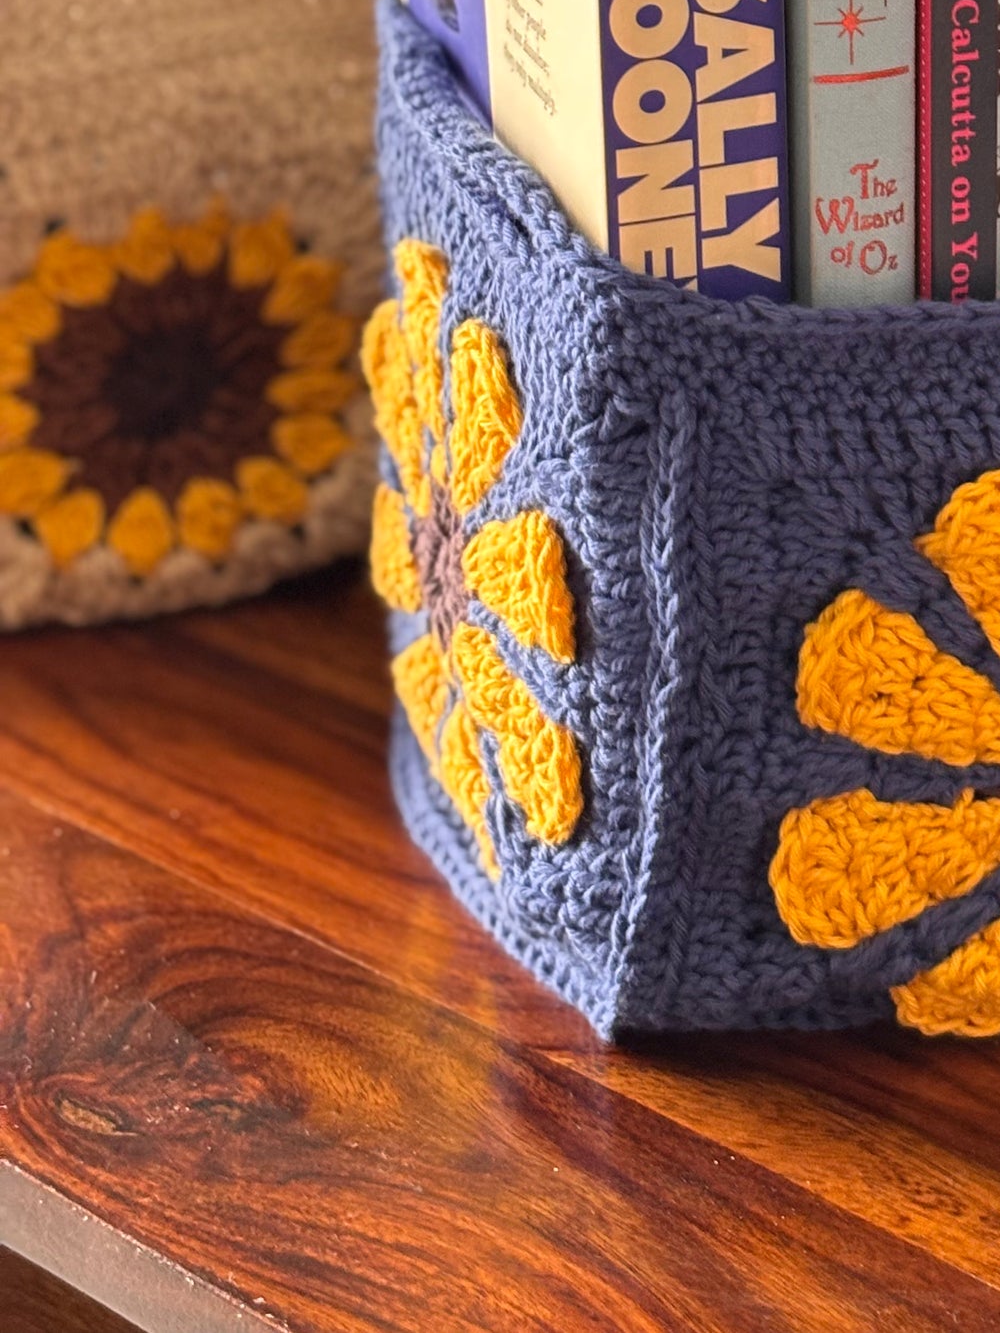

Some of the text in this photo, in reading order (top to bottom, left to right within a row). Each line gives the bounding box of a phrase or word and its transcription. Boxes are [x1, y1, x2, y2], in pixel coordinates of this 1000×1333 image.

[849, 158, 898, 200] The
[815, 195, 905, 235] Wizard
[951, 176, 972, 225] on
[830, 239, 898, 275] of Oz
